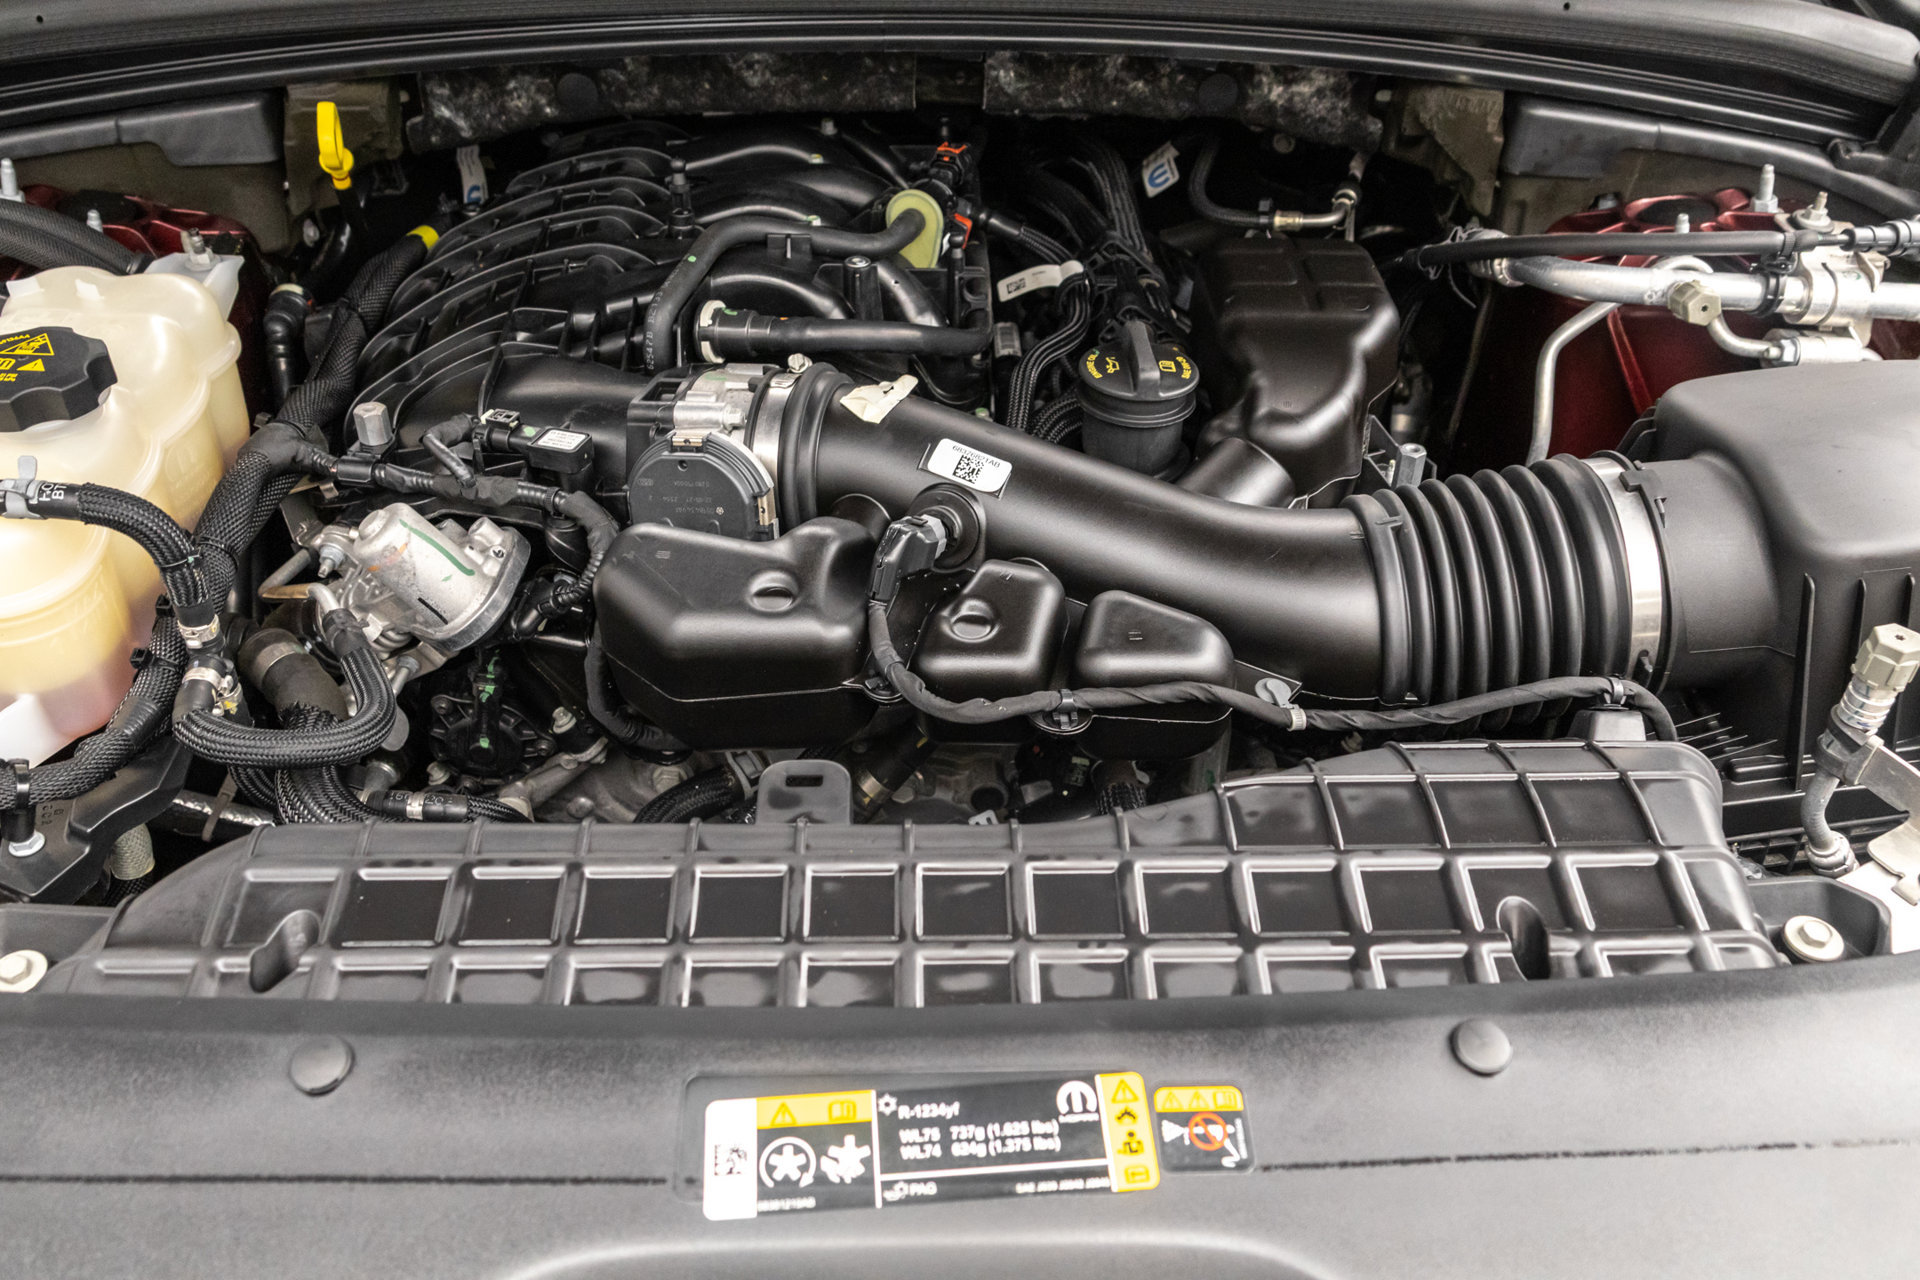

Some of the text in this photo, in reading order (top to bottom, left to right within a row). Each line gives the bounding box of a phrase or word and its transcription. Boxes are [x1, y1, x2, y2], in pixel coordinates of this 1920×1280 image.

[898, 1101, 960, 1120] R-1234yf
[899, 1126, 941, 1144] WL75
[950, 1125, 986, 1142] 737g
[899, 1143, 942, 1160] WL74
